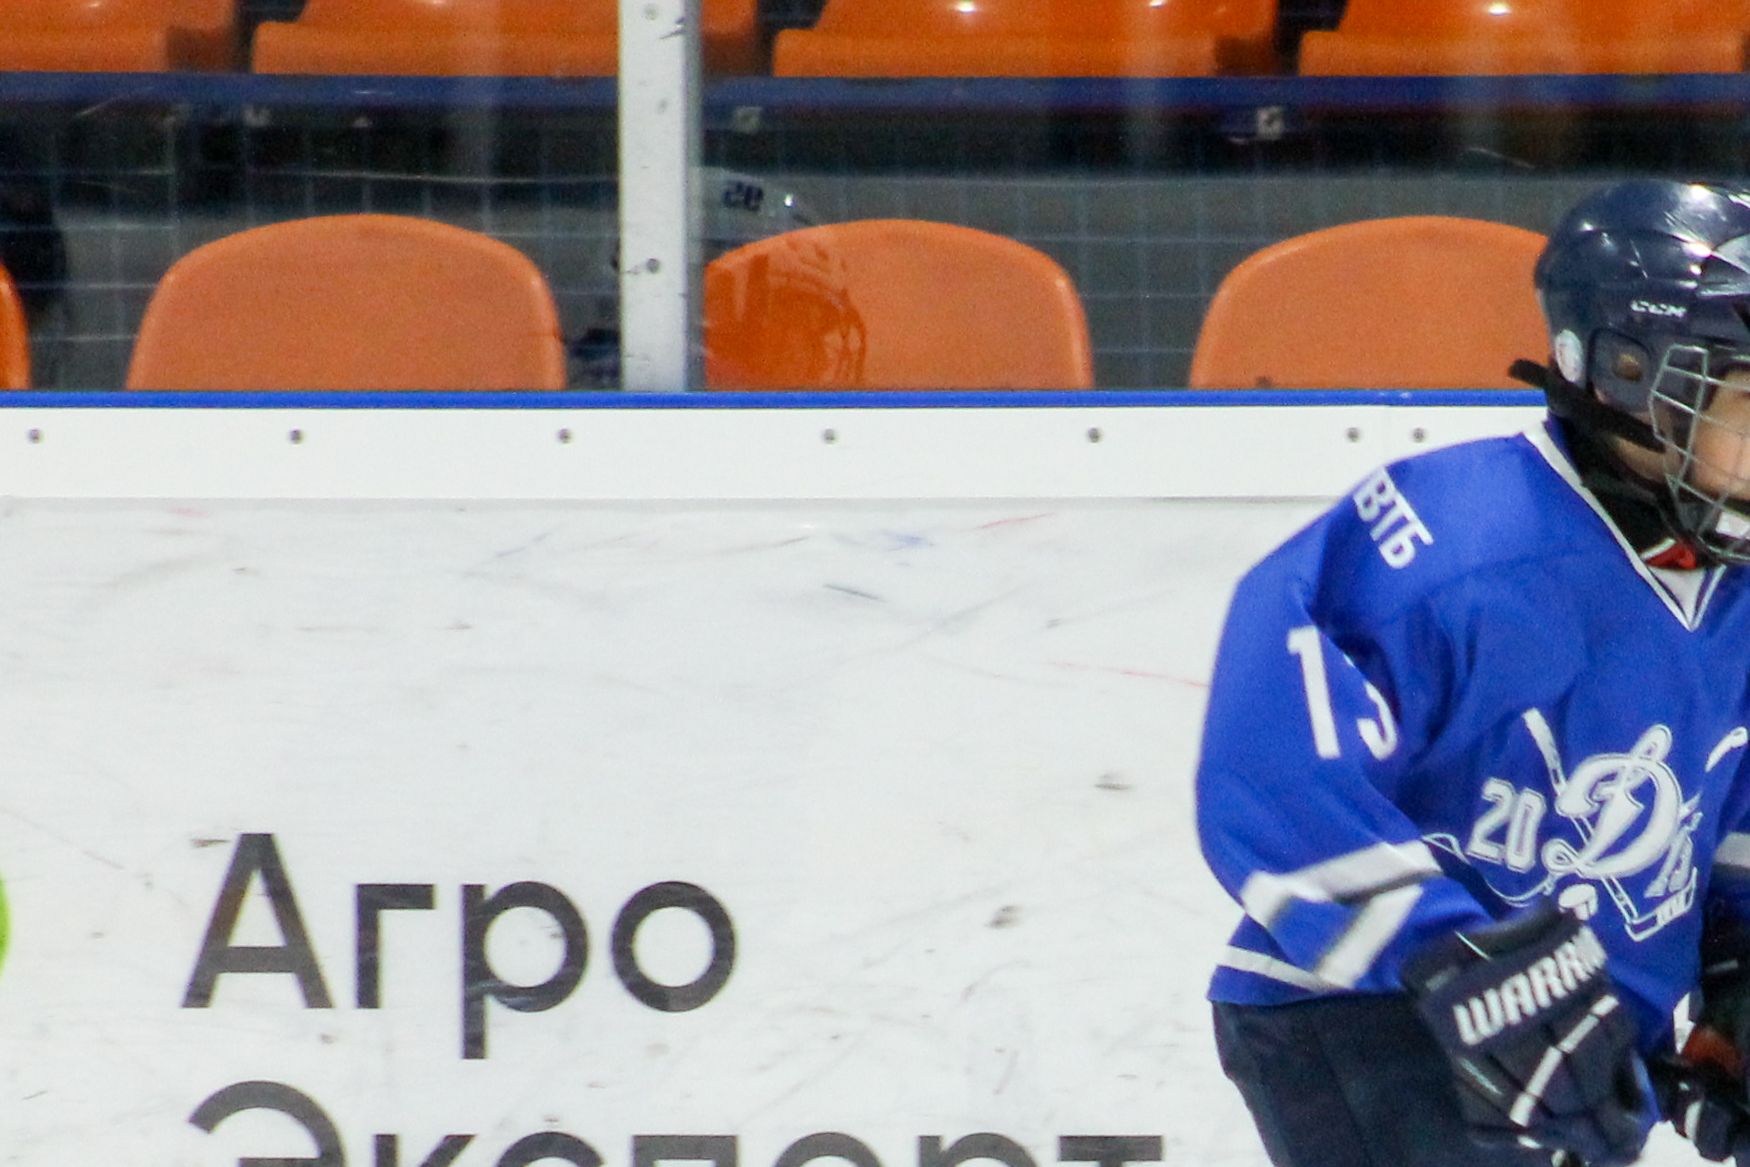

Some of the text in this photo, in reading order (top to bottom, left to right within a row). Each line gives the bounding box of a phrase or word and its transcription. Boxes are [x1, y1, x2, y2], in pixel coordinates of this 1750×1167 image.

[1352, 466, 1435, 570] ВТБ
[1466, 777, 1548, 874] 20
[182, 832, 736, 1060] Агро
[1452, 925, 1609, 1047] WARR
